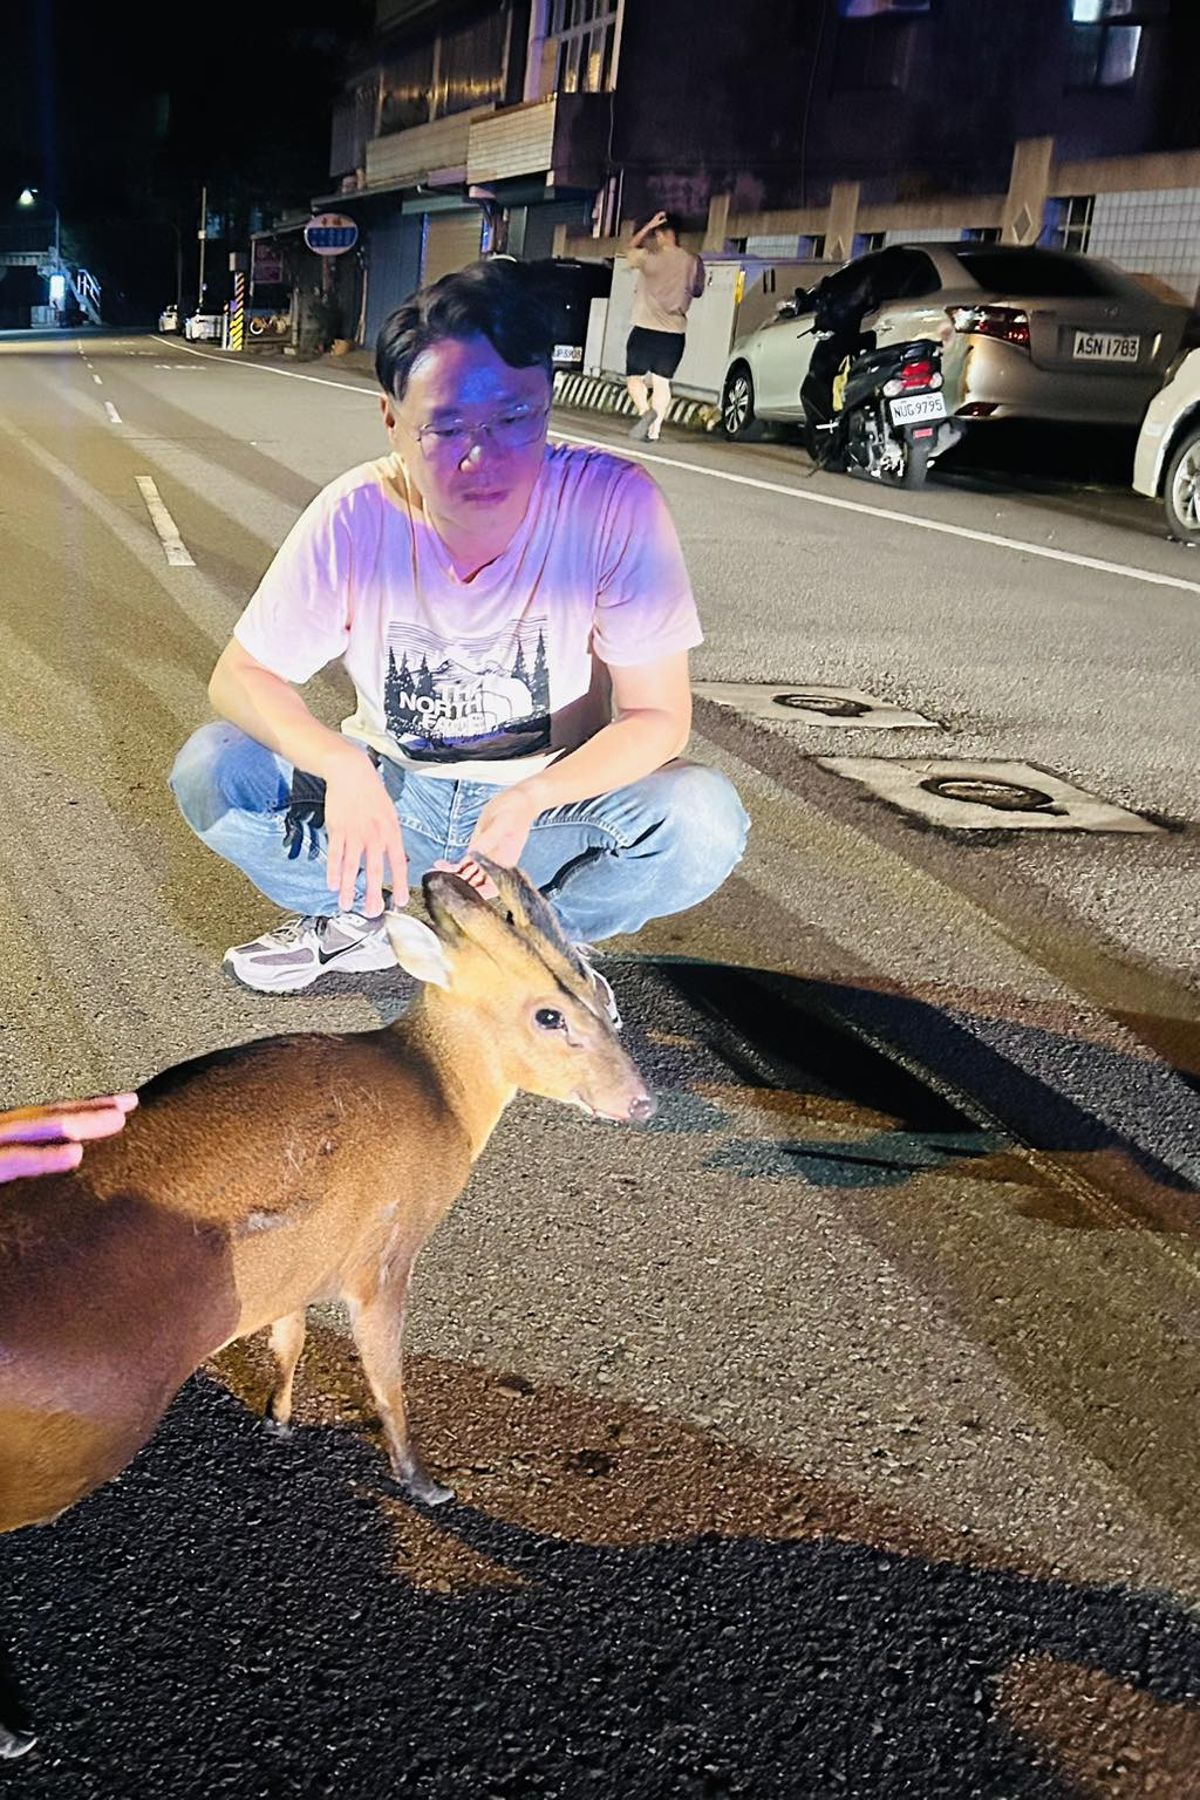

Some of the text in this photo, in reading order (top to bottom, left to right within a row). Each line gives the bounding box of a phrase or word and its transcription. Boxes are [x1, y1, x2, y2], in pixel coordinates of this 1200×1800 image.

[1076, 337, 1137, 357] ASN 1783
[400, 691, 483, 719] NORTH
